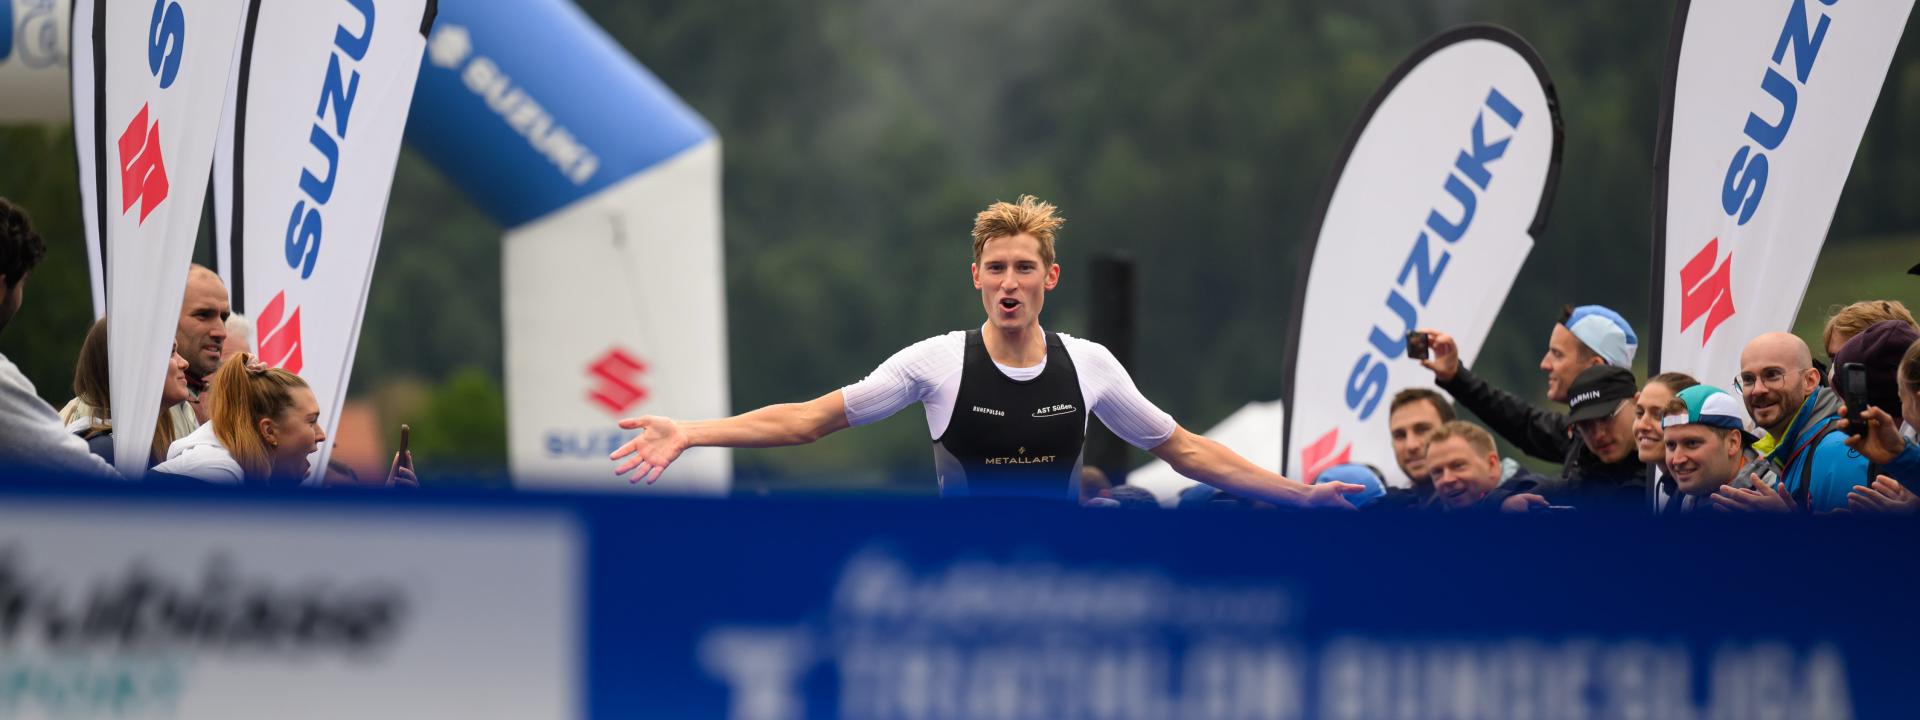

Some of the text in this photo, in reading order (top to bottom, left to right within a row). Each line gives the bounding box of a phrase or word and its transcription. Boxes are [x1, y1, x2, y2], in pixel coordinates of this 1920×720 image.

[285, 0, 376, 280] SUZU
[462, 56, 598, 185] SUZUKI
[1721, 0, 1839, 226] SUZ
[1344, 86, 1524, 422] SUZUKI
[985, 455, 1056, 465] METALLART
[1036, 407, 1051, 415] AST
